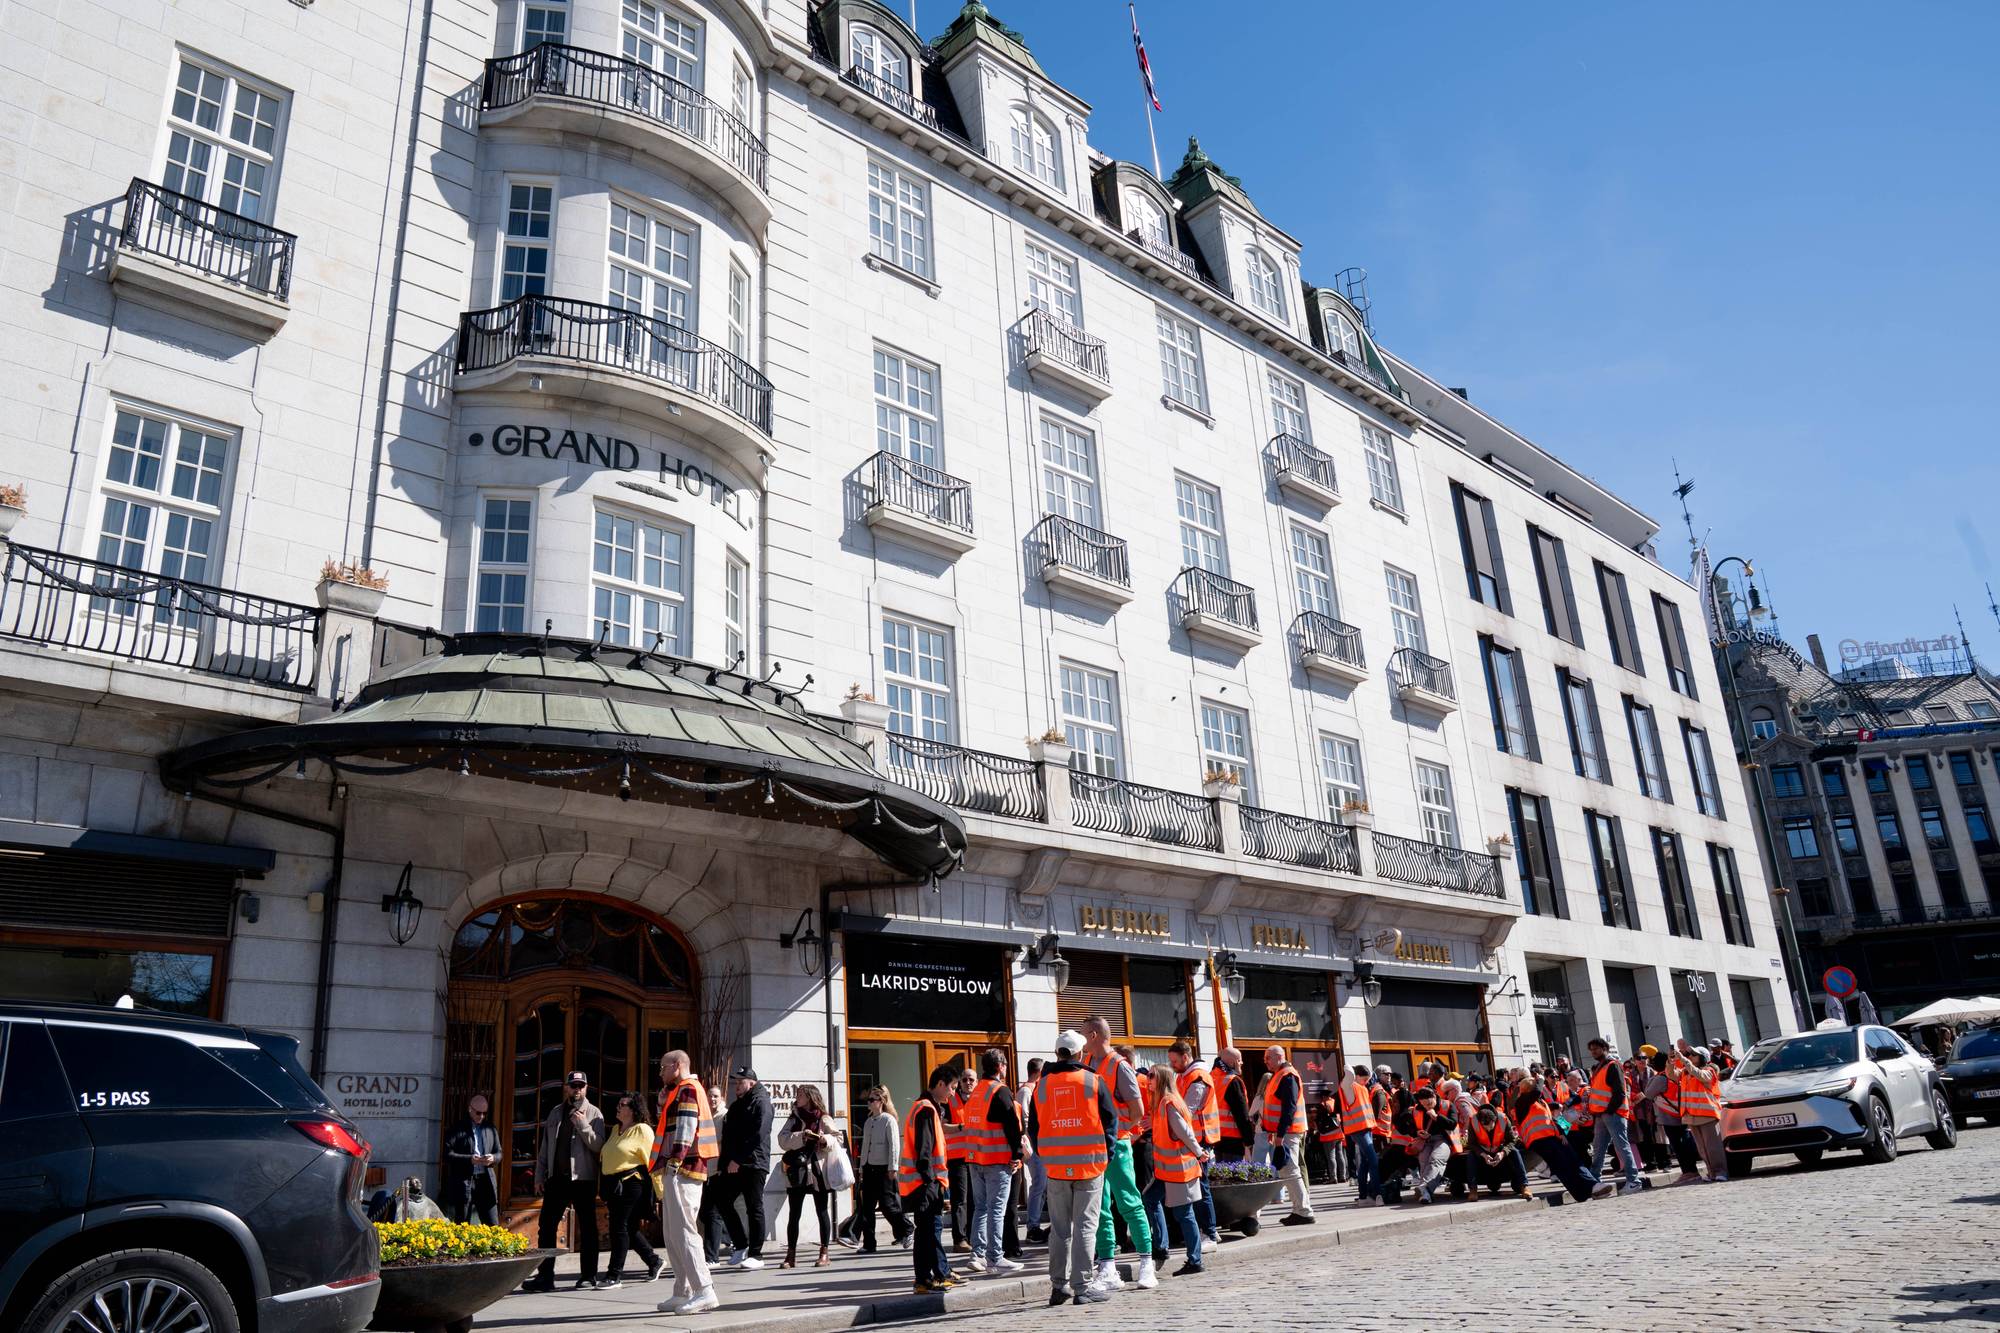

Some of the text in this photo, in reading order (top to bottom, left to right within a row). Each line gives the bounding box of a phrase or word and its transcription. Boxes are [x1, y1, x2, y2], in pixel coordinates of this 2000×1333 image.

[492, 424, 748, 531] GRAND HOTEL
[1864, 635, 1958, 660] fjordkraft
[1081, 905, 1170, 936] BJERKE
[1253, 925, 1311, 950] FREIA
[888, 961, 966, 972] DANISH CONFECTIONERY
[861, 973, 929, 992] LAKRIDS
[937, 976, 992, 995] BÜLOW
[1687, 974, 1706, 992] DNB
[1265, 1001, 1302, 1034] Freia
[337, 1075, 420, 1094] GRAND
[80, 1091, 150, 1107] 1-5 PASS
[344, 1099, 412, 1108] HOTEL OSLO
[1051, 1118, 1083, 1129] STREIK
[1766, 1115, 1791, 1126] 67513
